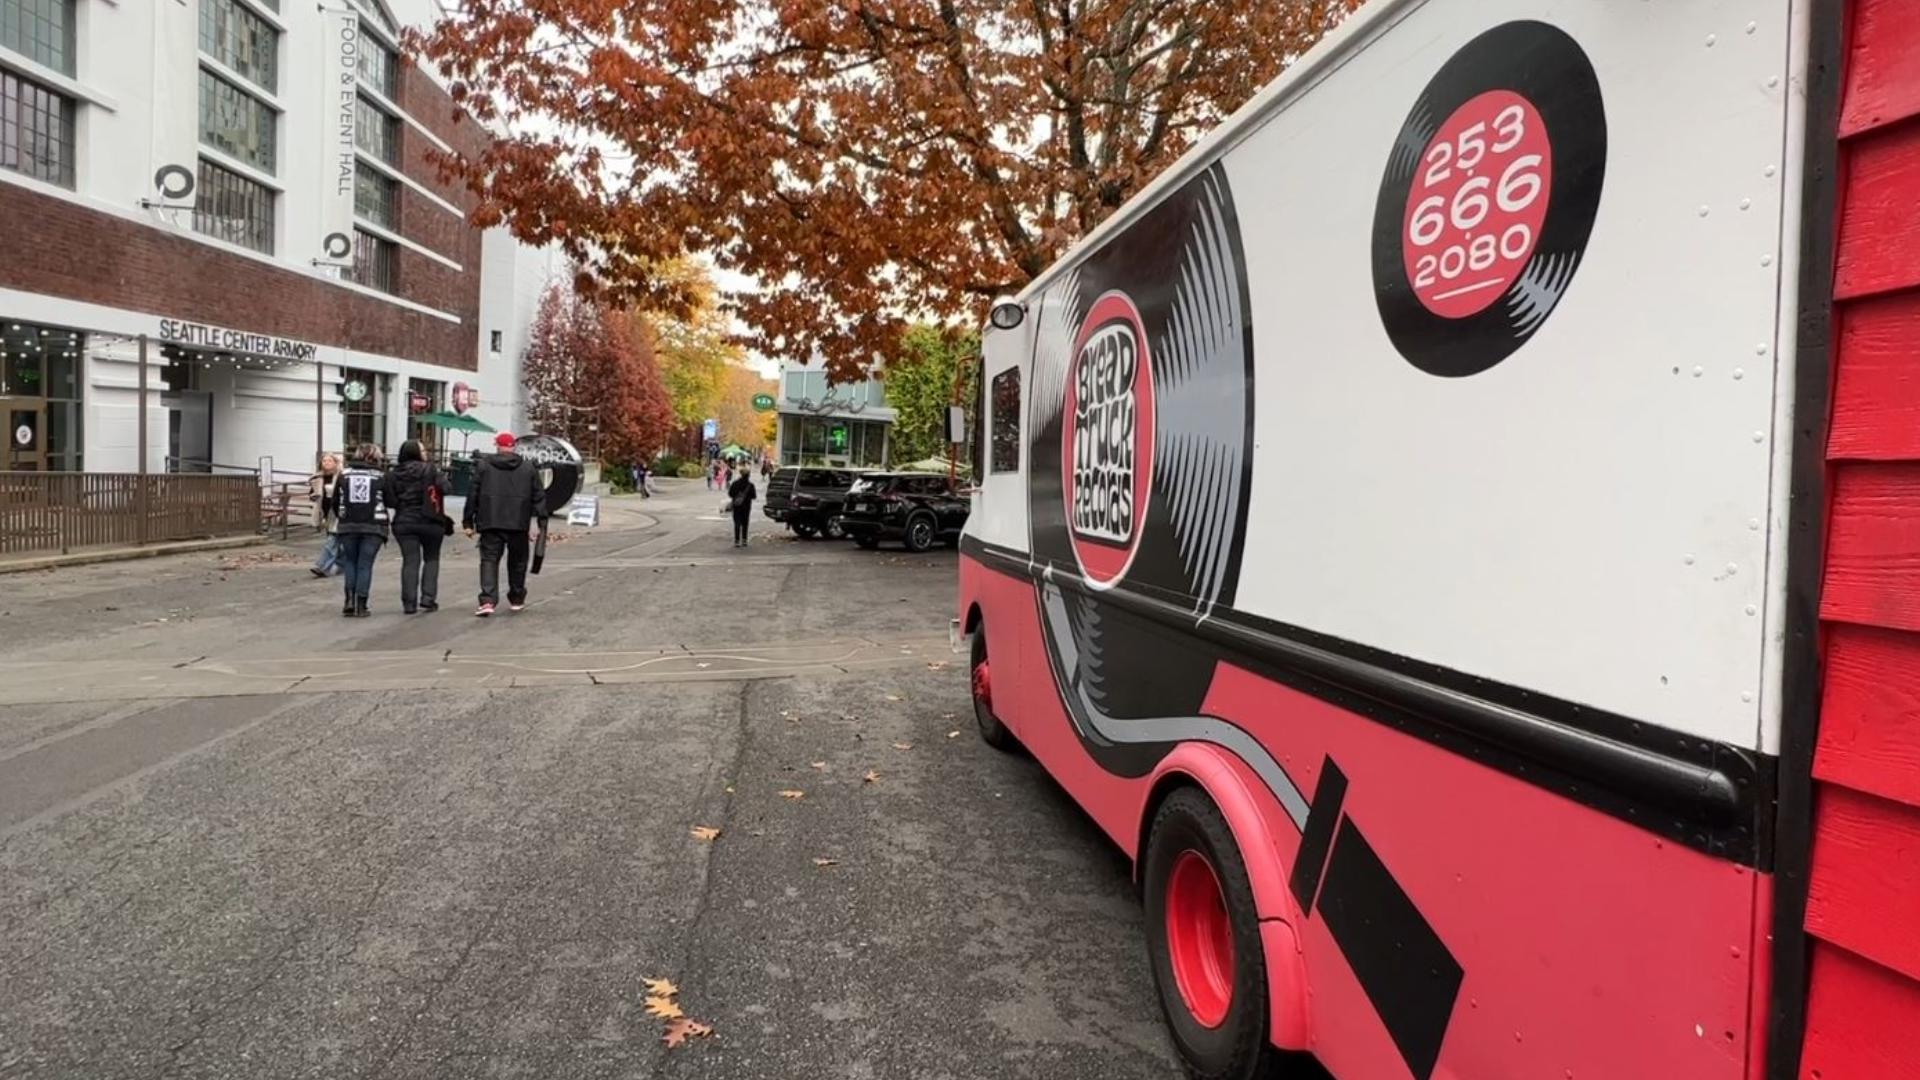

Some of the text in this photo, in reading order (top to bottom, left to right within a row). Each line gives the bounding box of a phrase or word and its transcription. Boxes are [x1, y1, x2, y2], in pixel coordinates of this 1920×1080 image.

[338, 17, 356, 197] FOOD & EVENT HALL
[1424, 104, 1525, 189] 253
[1409, 154, 1543, 246] 666
[1414, 223, 1531, 289] 2080
[160, 319, 317, 360] SEATTLE CENTER ARMORY
